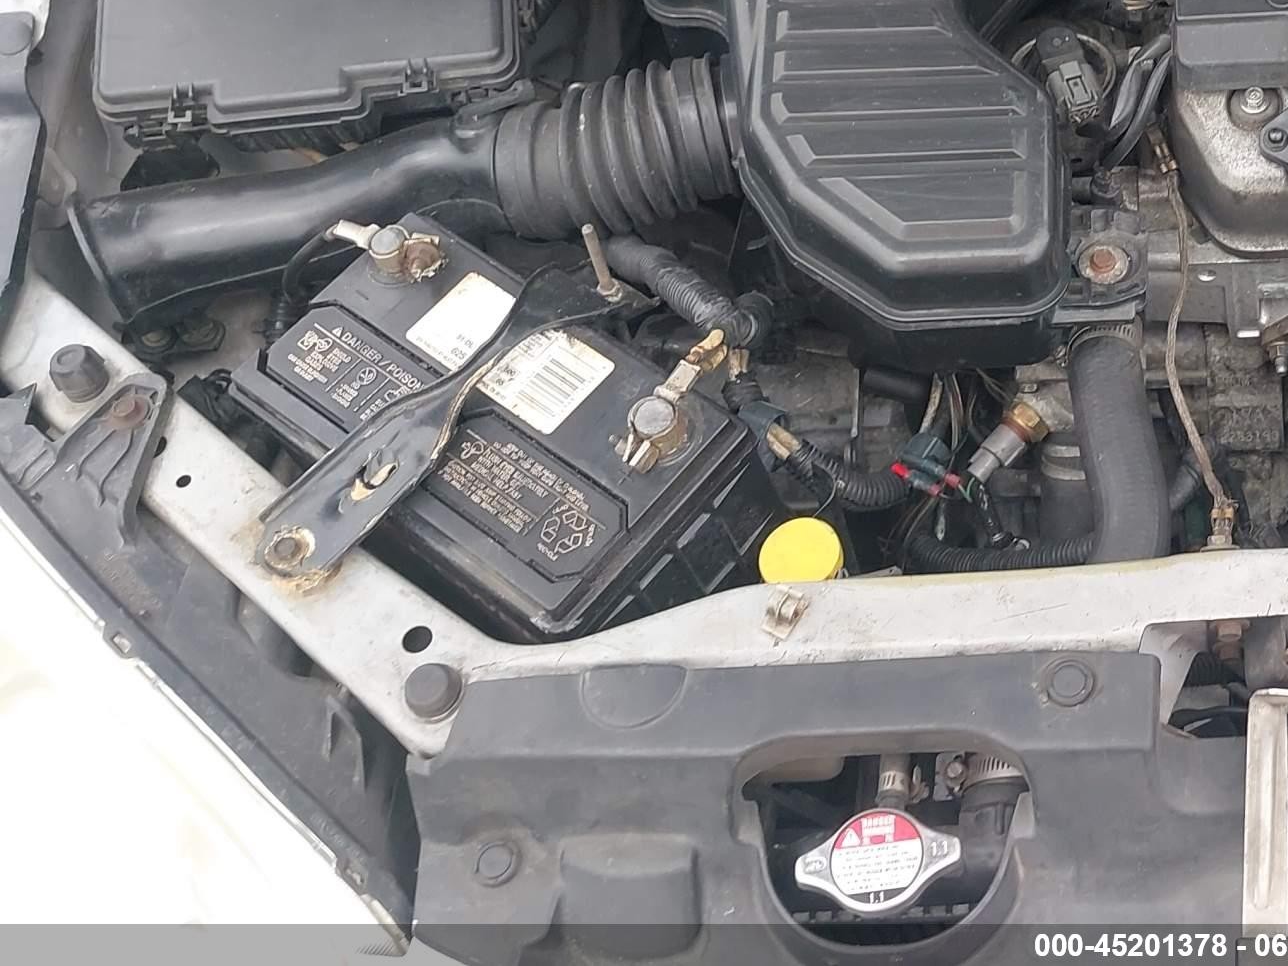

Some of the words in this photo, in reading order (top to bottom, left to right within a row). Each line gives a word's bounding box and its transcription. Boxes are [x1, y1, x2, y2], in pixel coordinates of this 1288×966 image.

[340, 331, 383, 364] DANGER
[386, 362, 426, 392] POISON
[869, 891, 885, 904] 1.1
